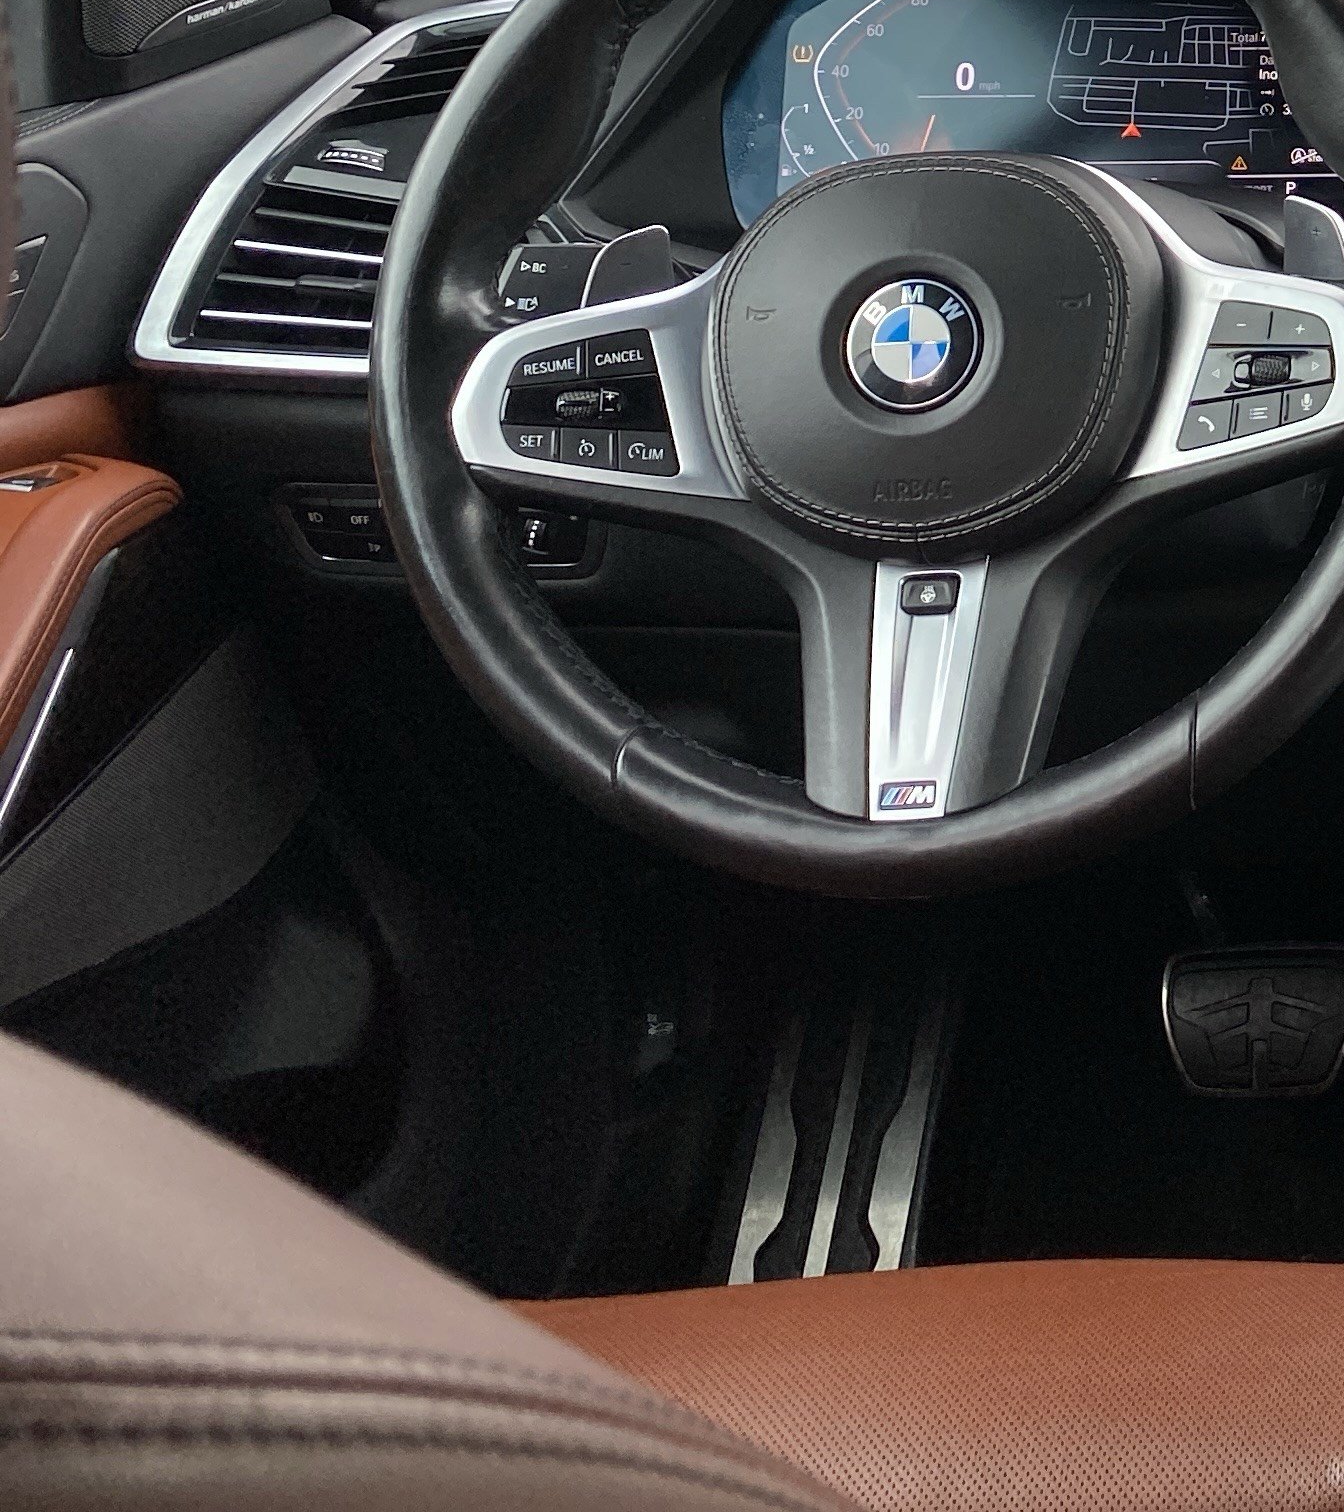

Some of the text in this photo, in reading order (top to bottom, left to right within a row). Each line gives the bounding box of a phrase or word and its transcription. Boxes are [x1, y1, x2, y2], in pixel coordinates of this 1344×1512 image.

[866, 24, 885, 38] 60
[1230, 31, 1258, 44] Total
[831, 64, 850, 78] 40
[955, 62, 1001, 92] 0 mph
[1259, 69, 1278, 80] Ino
[845, 106, 864, 120] 20
[874, 142, 890, 156] 10
[1285, 181, 1296, 194] P
[532, 262, 547, 274] BC
[862, 285, 966, 326] BMW
[595, 349, 644, 367] CANCEL
[523, 357, 576, 376] RESUME
[519, 435, 544, 448] SET
[642, 448, 664, 461] LIM
[873, 479, 954, 502] AIRBAG
[350, 515, 370, 526] OFF
[906, 785, 936, 804] M
